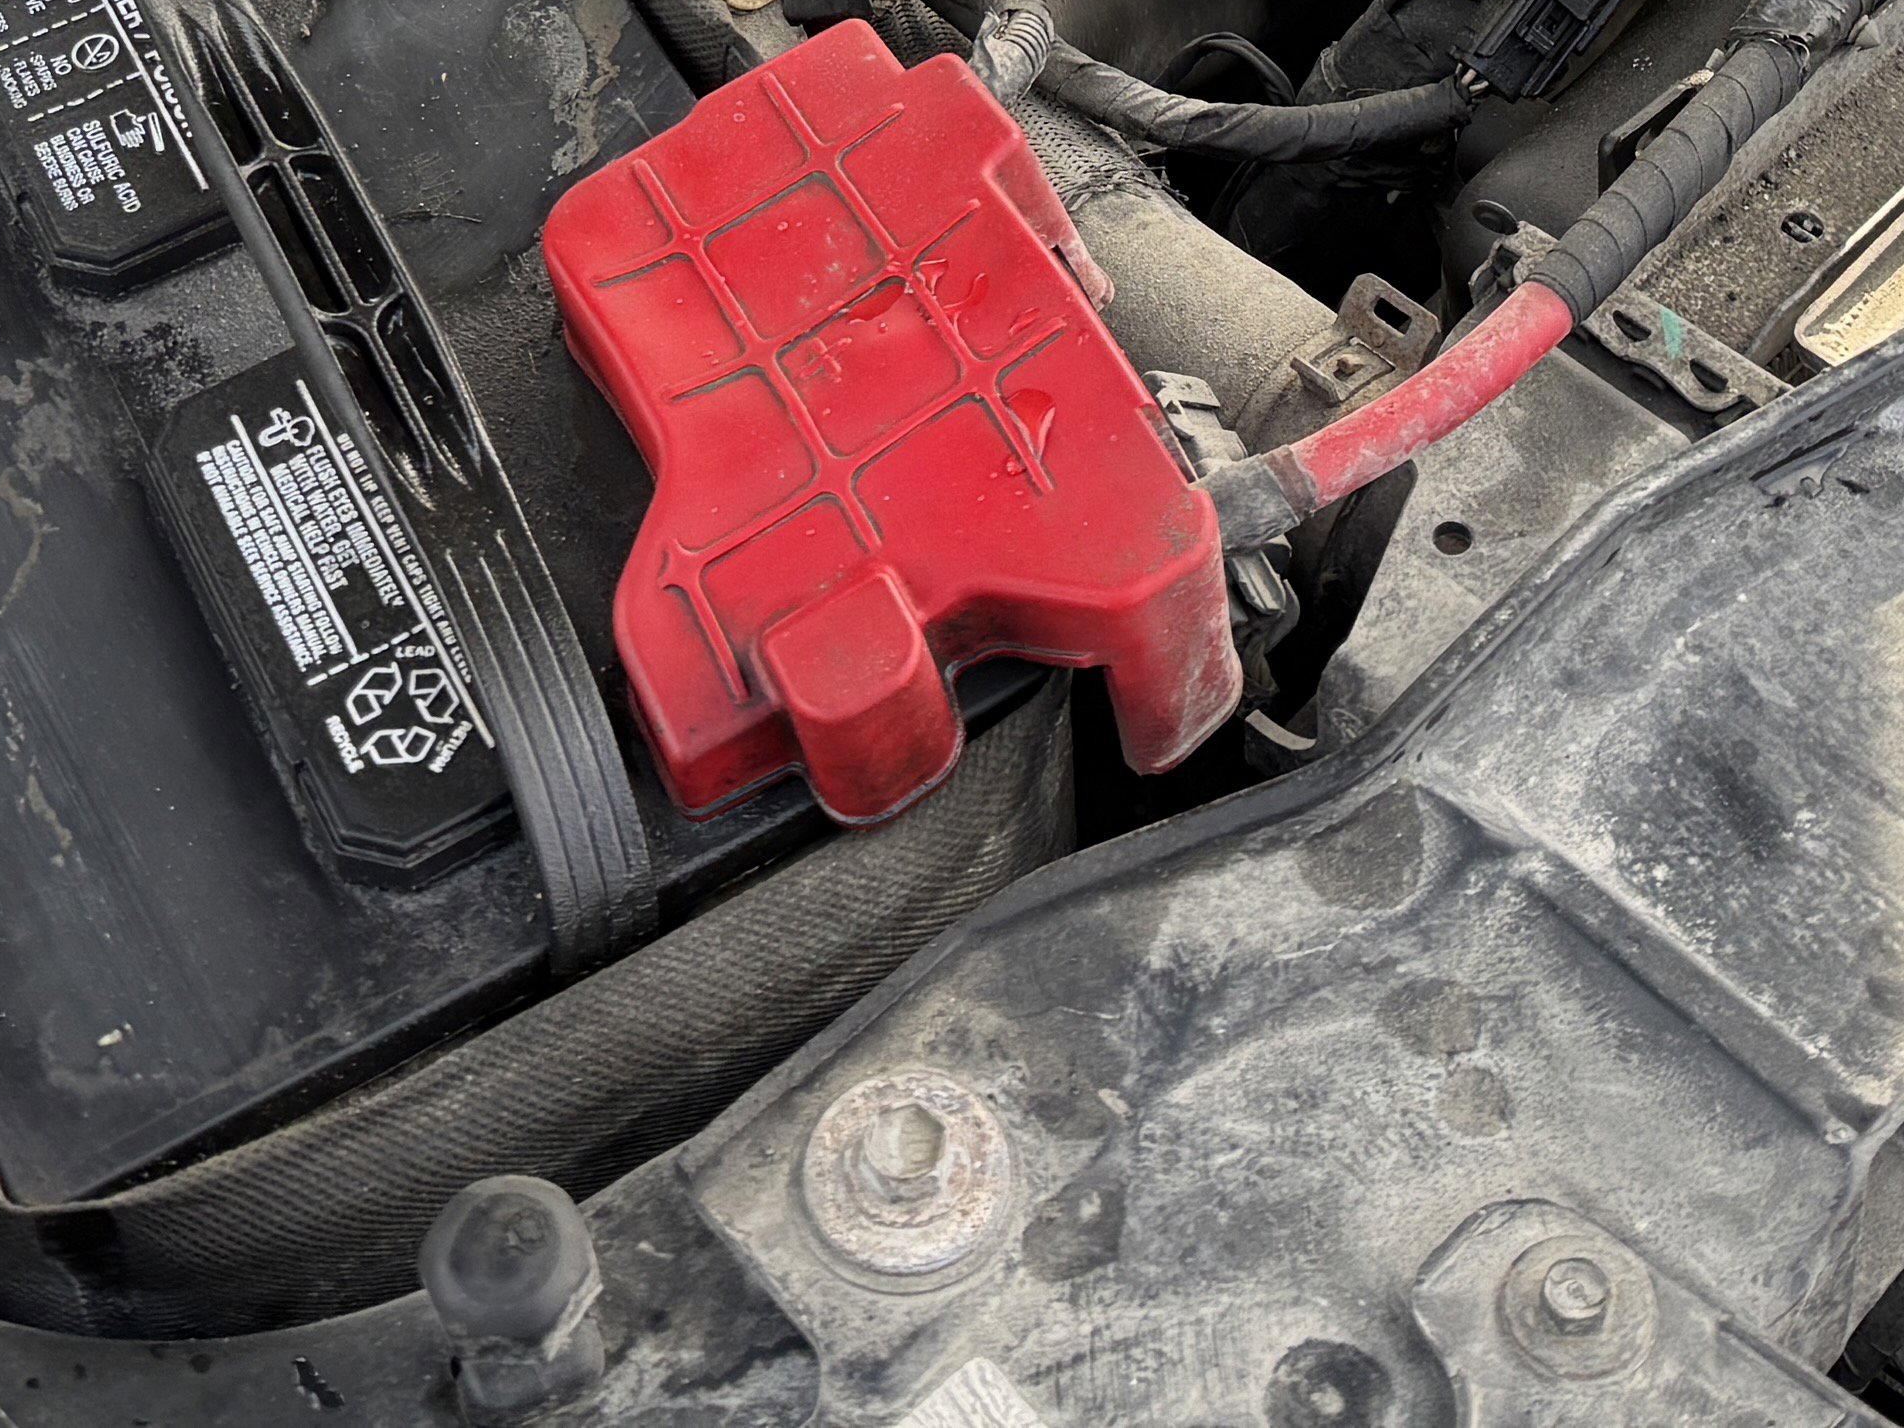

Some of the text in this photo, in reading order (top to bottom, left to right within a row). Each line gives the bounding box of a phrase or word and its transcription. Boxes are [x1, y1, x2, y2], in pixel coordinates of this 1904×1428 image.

[0, 67, 27, 108] SMOKING
[14, 60, 40, 96] FLAMES
[30, 54, 57, 90] SPARKS
[50, 55, 72, 75] NO
[34, 142, 78, 211] SEVERE BURNS
[50, 134, 95, 204] BLINDNESS OR
[66, 127, 105, 184] CAN CAUSE
[83, 120, 141, 212] SULFURIC ACID
[197, 451, 212, 462] IF
[201, 463, 222, 485] NOT
[205, 445, 259, 518] INSTRUCTIONS
[253, 529, 283, 572] VEHICLE
[211, 485, 248, 537] AVAILABLE
[269, 463, 348, 590] MEDICAL HELP FAST
[288, 453, 319, 492] WITH
[332, 540, 359, 568] GET
[306, 445, 404, 605] FLUSH EYES IMMEDIATELY
[237, 535, 260, 564] SEEK
[250, 486, 269, 509] FOR
[260, 507, 283, 535] SAFE
[273, 535, 297, 561] JUMP
[287, 562, 322, 611] STARTING
[312, 610, 342, 654] FOLLOW
[370, 496, 395, 523] KEEP
[386, 524, 410, 553] VENT
[402, 554, 426, 585] CAPS
[419, 584, 444, 619] TIGHT
[249, 561, 281, 605] SERVICE
[395, 643, 436, 659] LEAD
[326, 715, 364, 773] RECYCLE
[427, 720, 474, 774] RETURN
